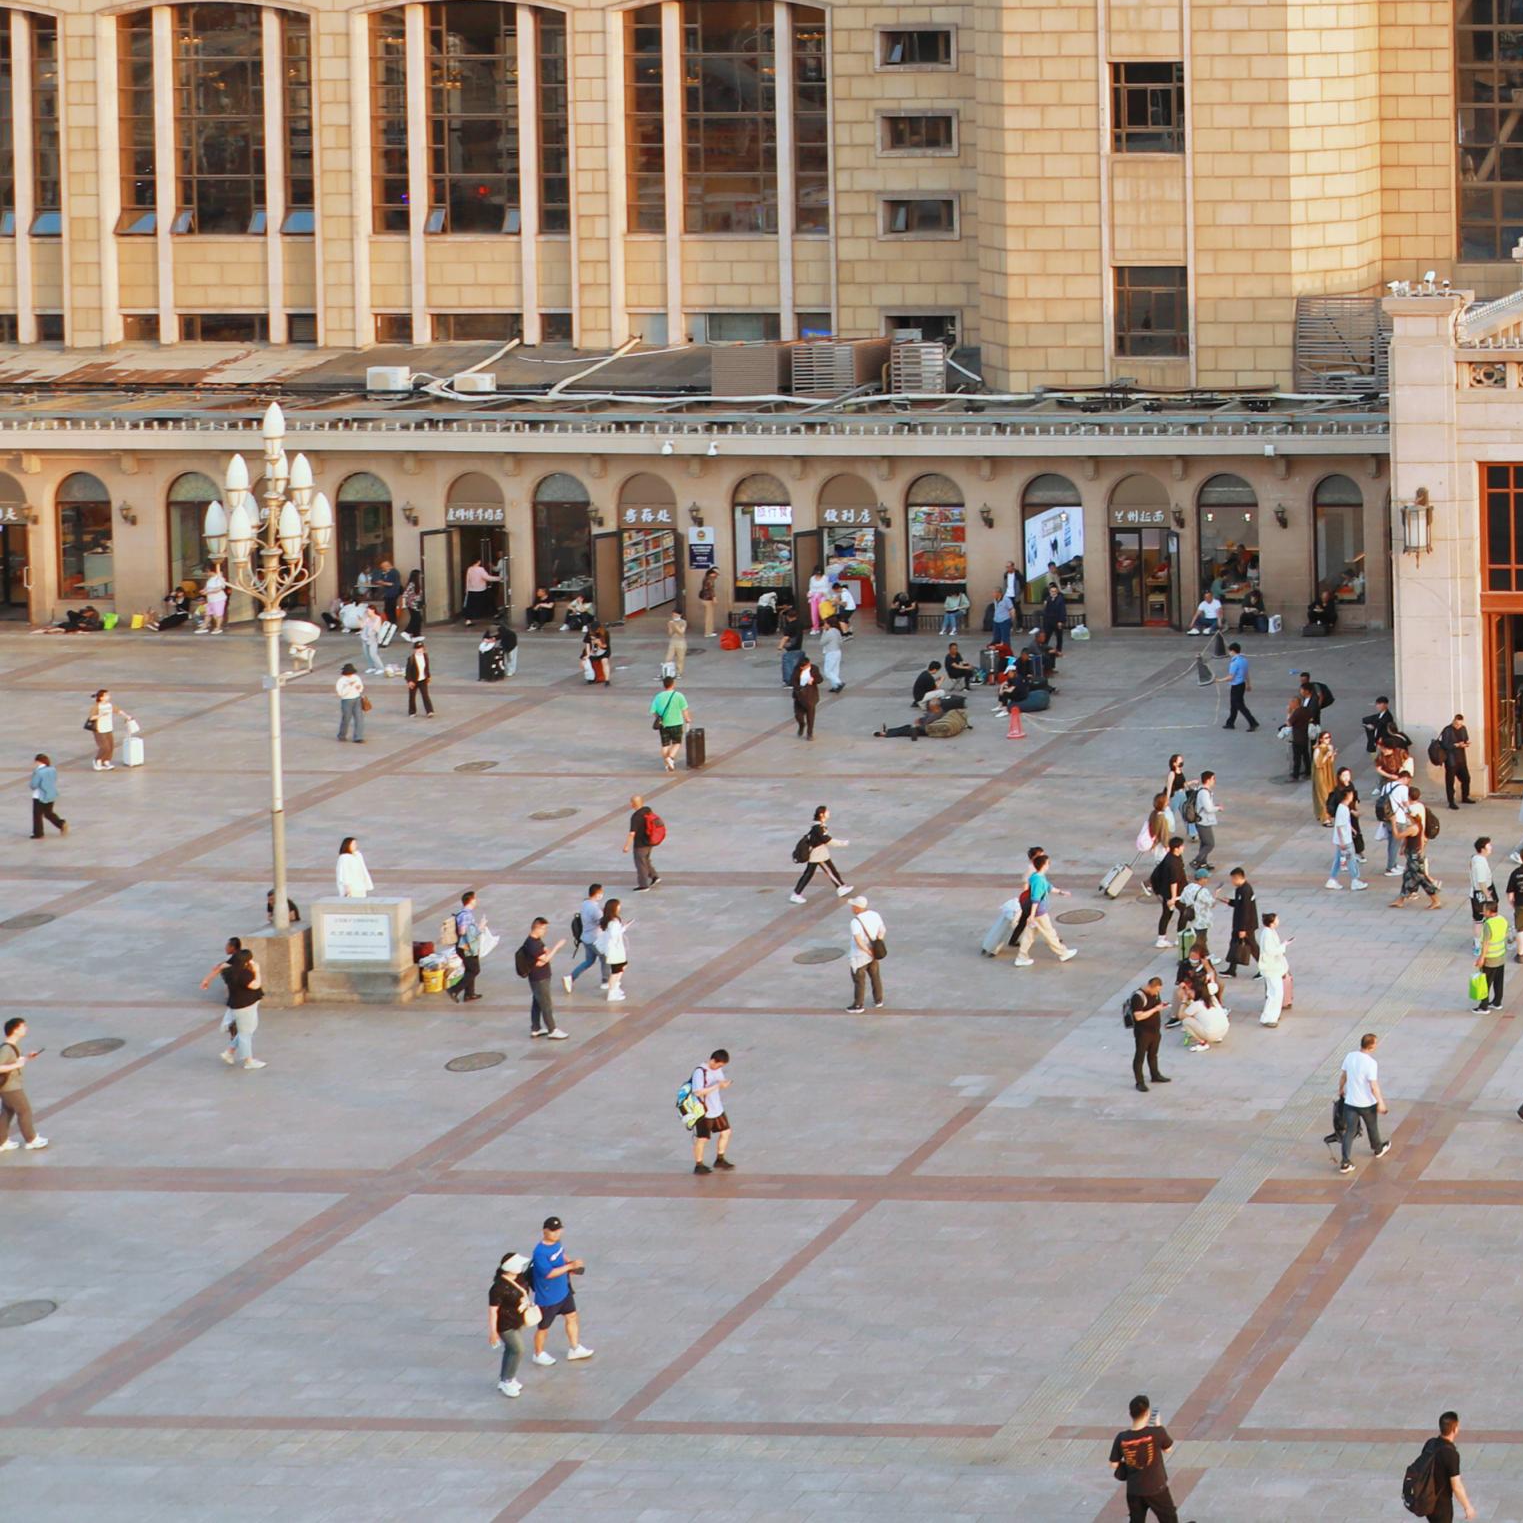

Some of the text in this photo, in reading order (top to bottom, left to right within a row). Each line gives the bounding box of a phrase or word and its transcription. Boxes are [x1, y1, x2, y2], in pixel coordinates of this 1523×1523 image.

[824, 508, 872, 523] 便利店
[1114, 510, 1165, 524] 兰州拉面
